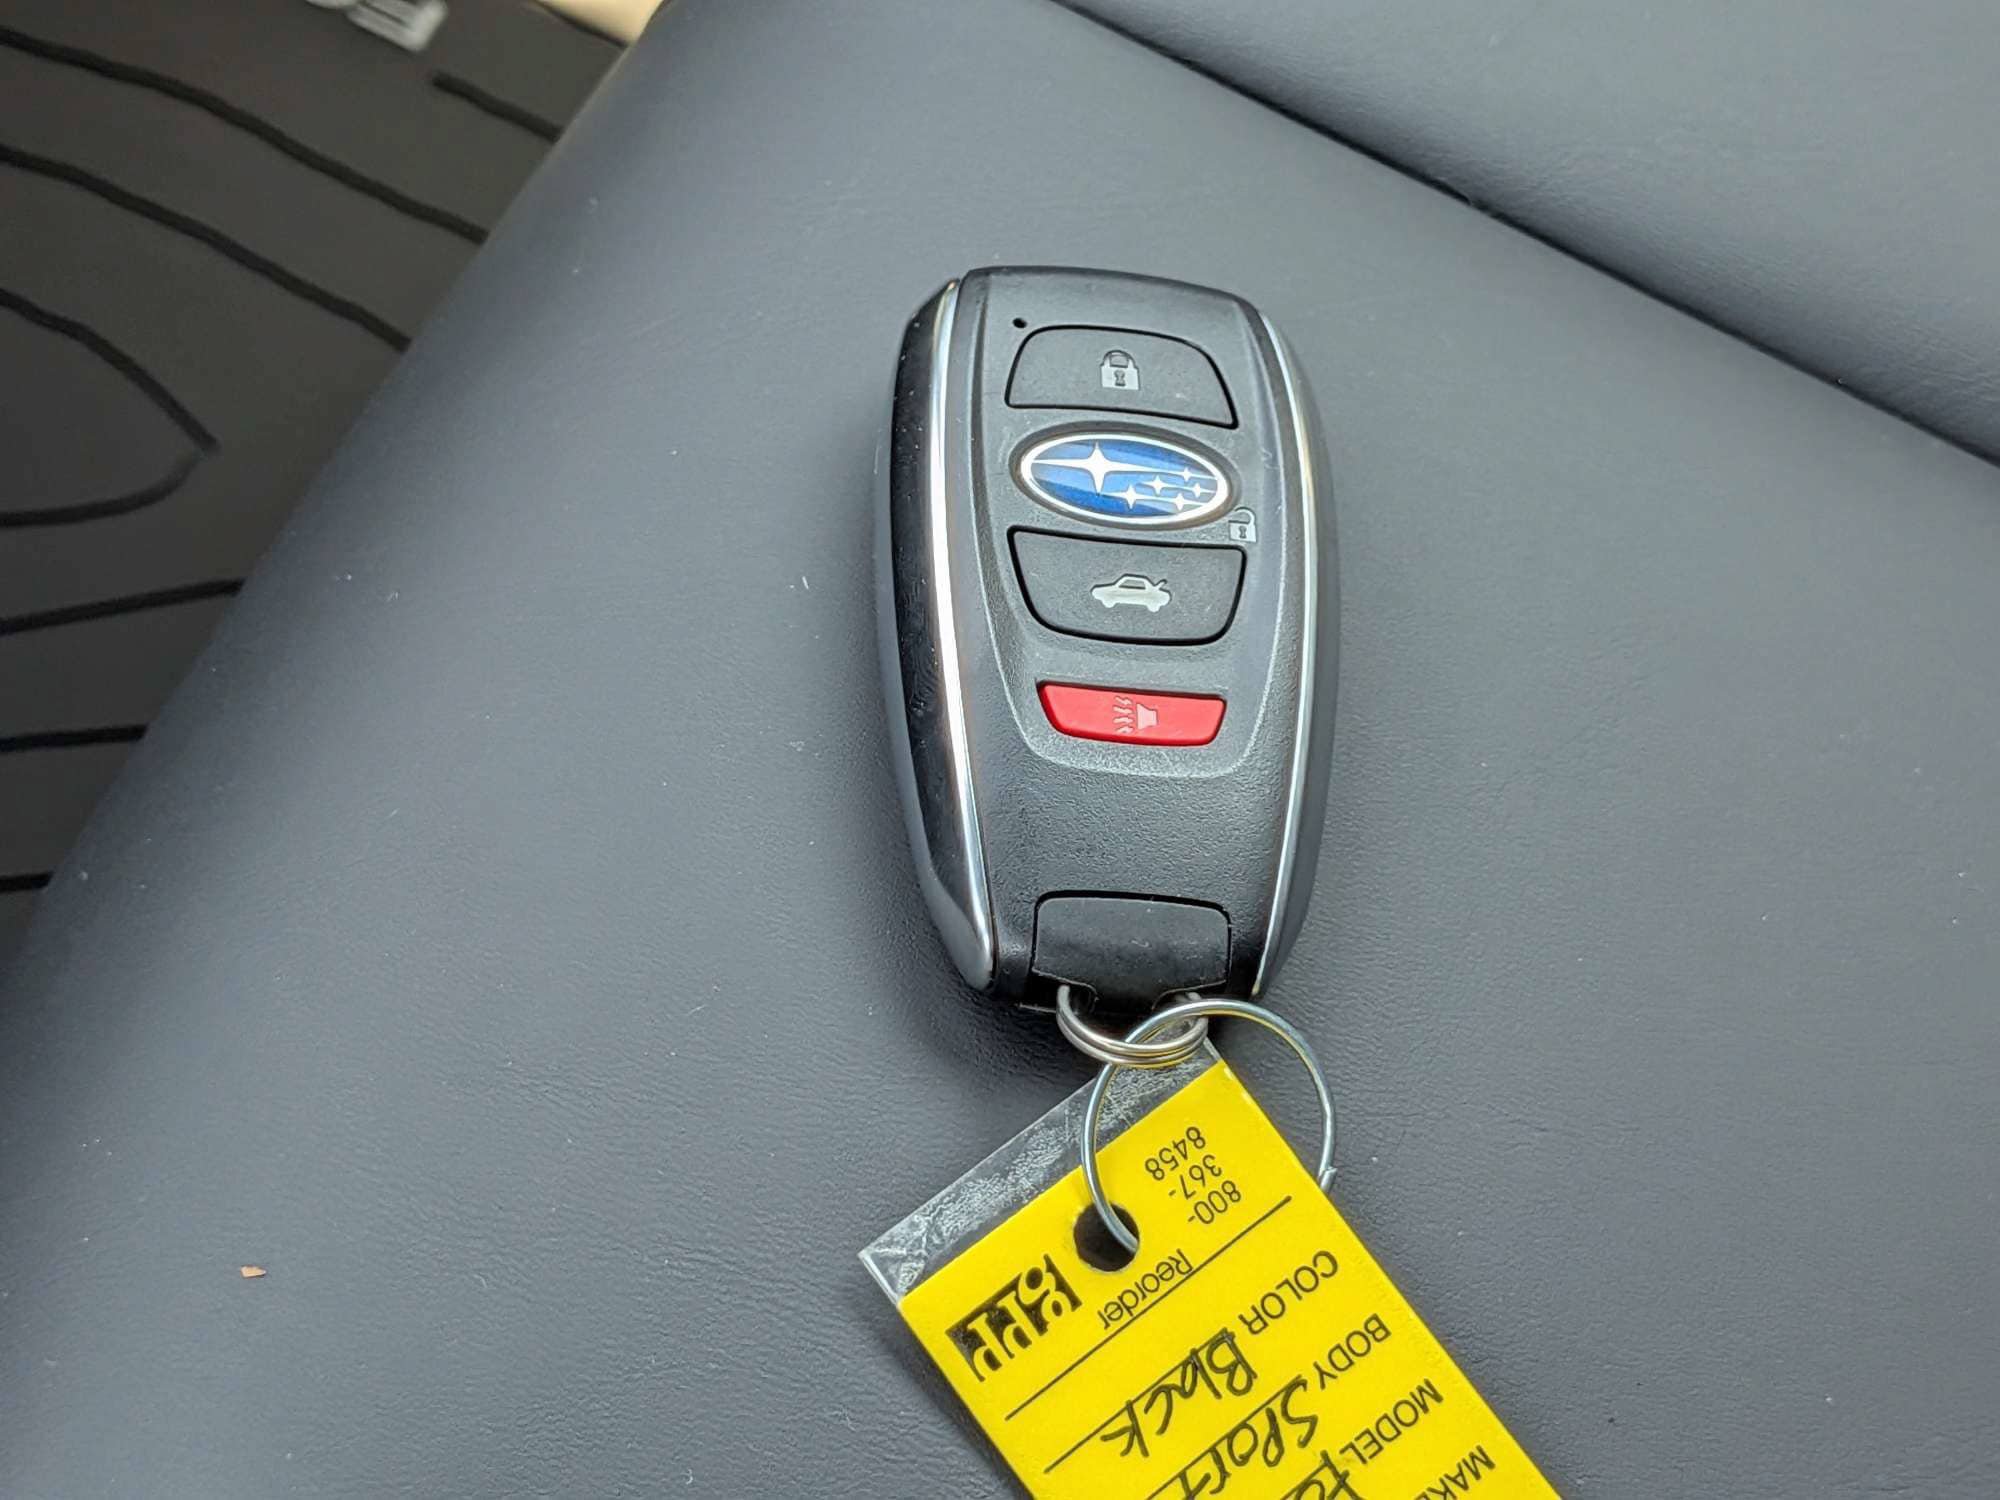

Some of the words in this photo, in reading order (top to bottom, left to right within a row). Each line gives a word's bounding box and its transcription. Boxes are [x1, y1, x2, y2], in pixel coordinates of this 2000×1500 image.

[1144, 1126, 1206, 1181] 8458
[1168, 1154, 1222, 1200] 367-
[1187, 1180, 1241, 1225] 800-
[1097, 1249, 1193, 1330] Reorder
[1238, 1250, 1338, 1335] COLOR
[1313, 1313, 1391, 1390] BODY
[1100, 1328, 1258, 1458] Black
[1339, 1378, 1443, 1464] MODEL
